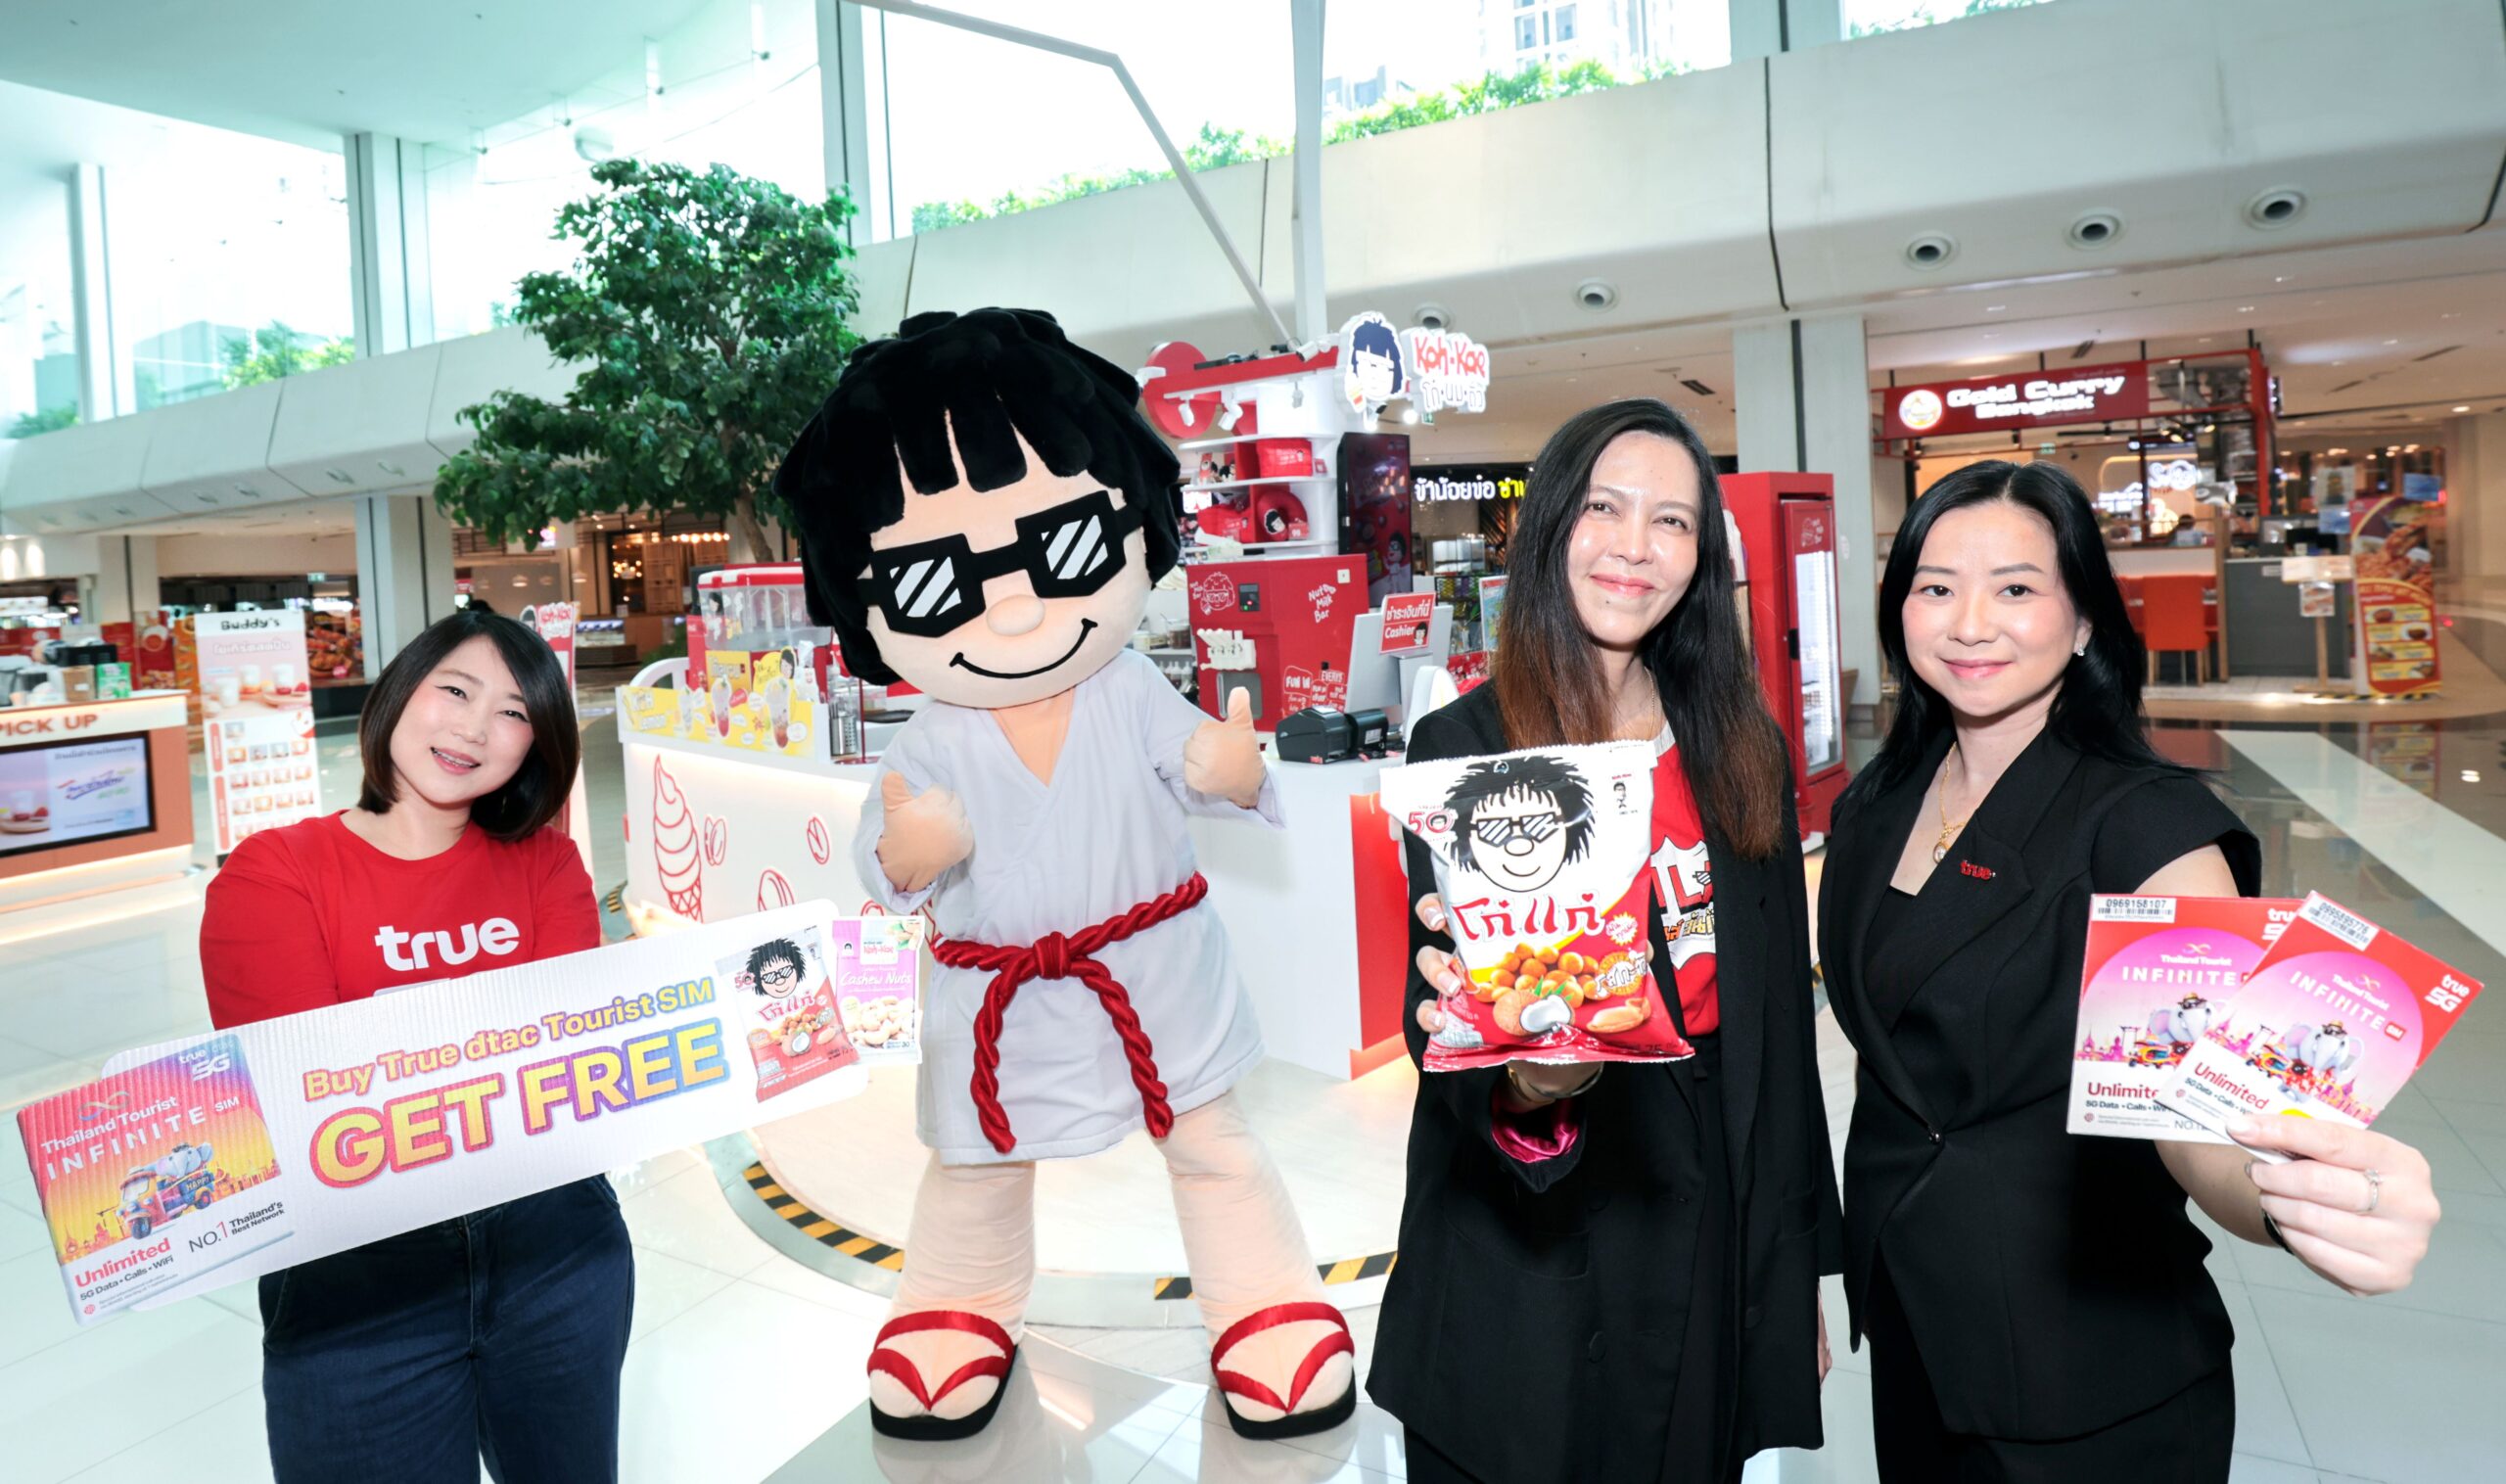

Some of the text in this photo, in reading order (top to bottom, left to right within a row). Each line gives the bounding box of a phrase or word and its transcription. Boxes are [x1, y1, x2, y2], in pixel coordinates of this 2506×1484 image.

[2023, 375, 2126, 400] Curry
[1975, 394, 2095, 420] Bangkok
[220, 617, 281, 630] Buddy's
[1314, 609, 1330, 624] Bar
[1384, 624, 1415, 639] Cashier
[0, 714, 98, 736] ICK UP
[1960, 860, 1992, 880] true
[2267, 907, 2297, 922] tru
[374, 916, 520, 971] true
[2261, 923, 2291, 941] 5
[841, 970, 912, 987] Cashew Nuts
[2122, 965, 2238, 987] INFINITE
[2440, 973, 2471, 998] true
[2290, 970, 2386, 1031] INFINITE
[2425, 986, 2463, 1013] 5G
[304, 976, 716, 1102] Buy True dtac Tourist SIM
[178, 1048, 208, 1065] true
[193, 1052, 231, 1082] 5G
[2087, 1082, 2158, 1099] Unlimit
[2194, 1062, 2270, 1111] Unlimited
[309, 1017, 731, 1188] GET FREE
[2099, 1100, 2119, 1110] Data
[40, 1094, 180, 1155] Thailand Tourist
[46, 1095, 241, 1181] INFINITE SIM
[228, 1201, 283, 1229] Thailand's
[231, 1209, 286, 1235] Best Network
[188, 1221, 229, 1253] NO.1
[74, 1237, 171, 1288] Unlimited
[79, 1289, 96, 1301] 5G
[96, 1280, 119, 1295] Data
[123, 1267, 149, 1282] Calls
[153, 1255, 174, 1271] WiFi
